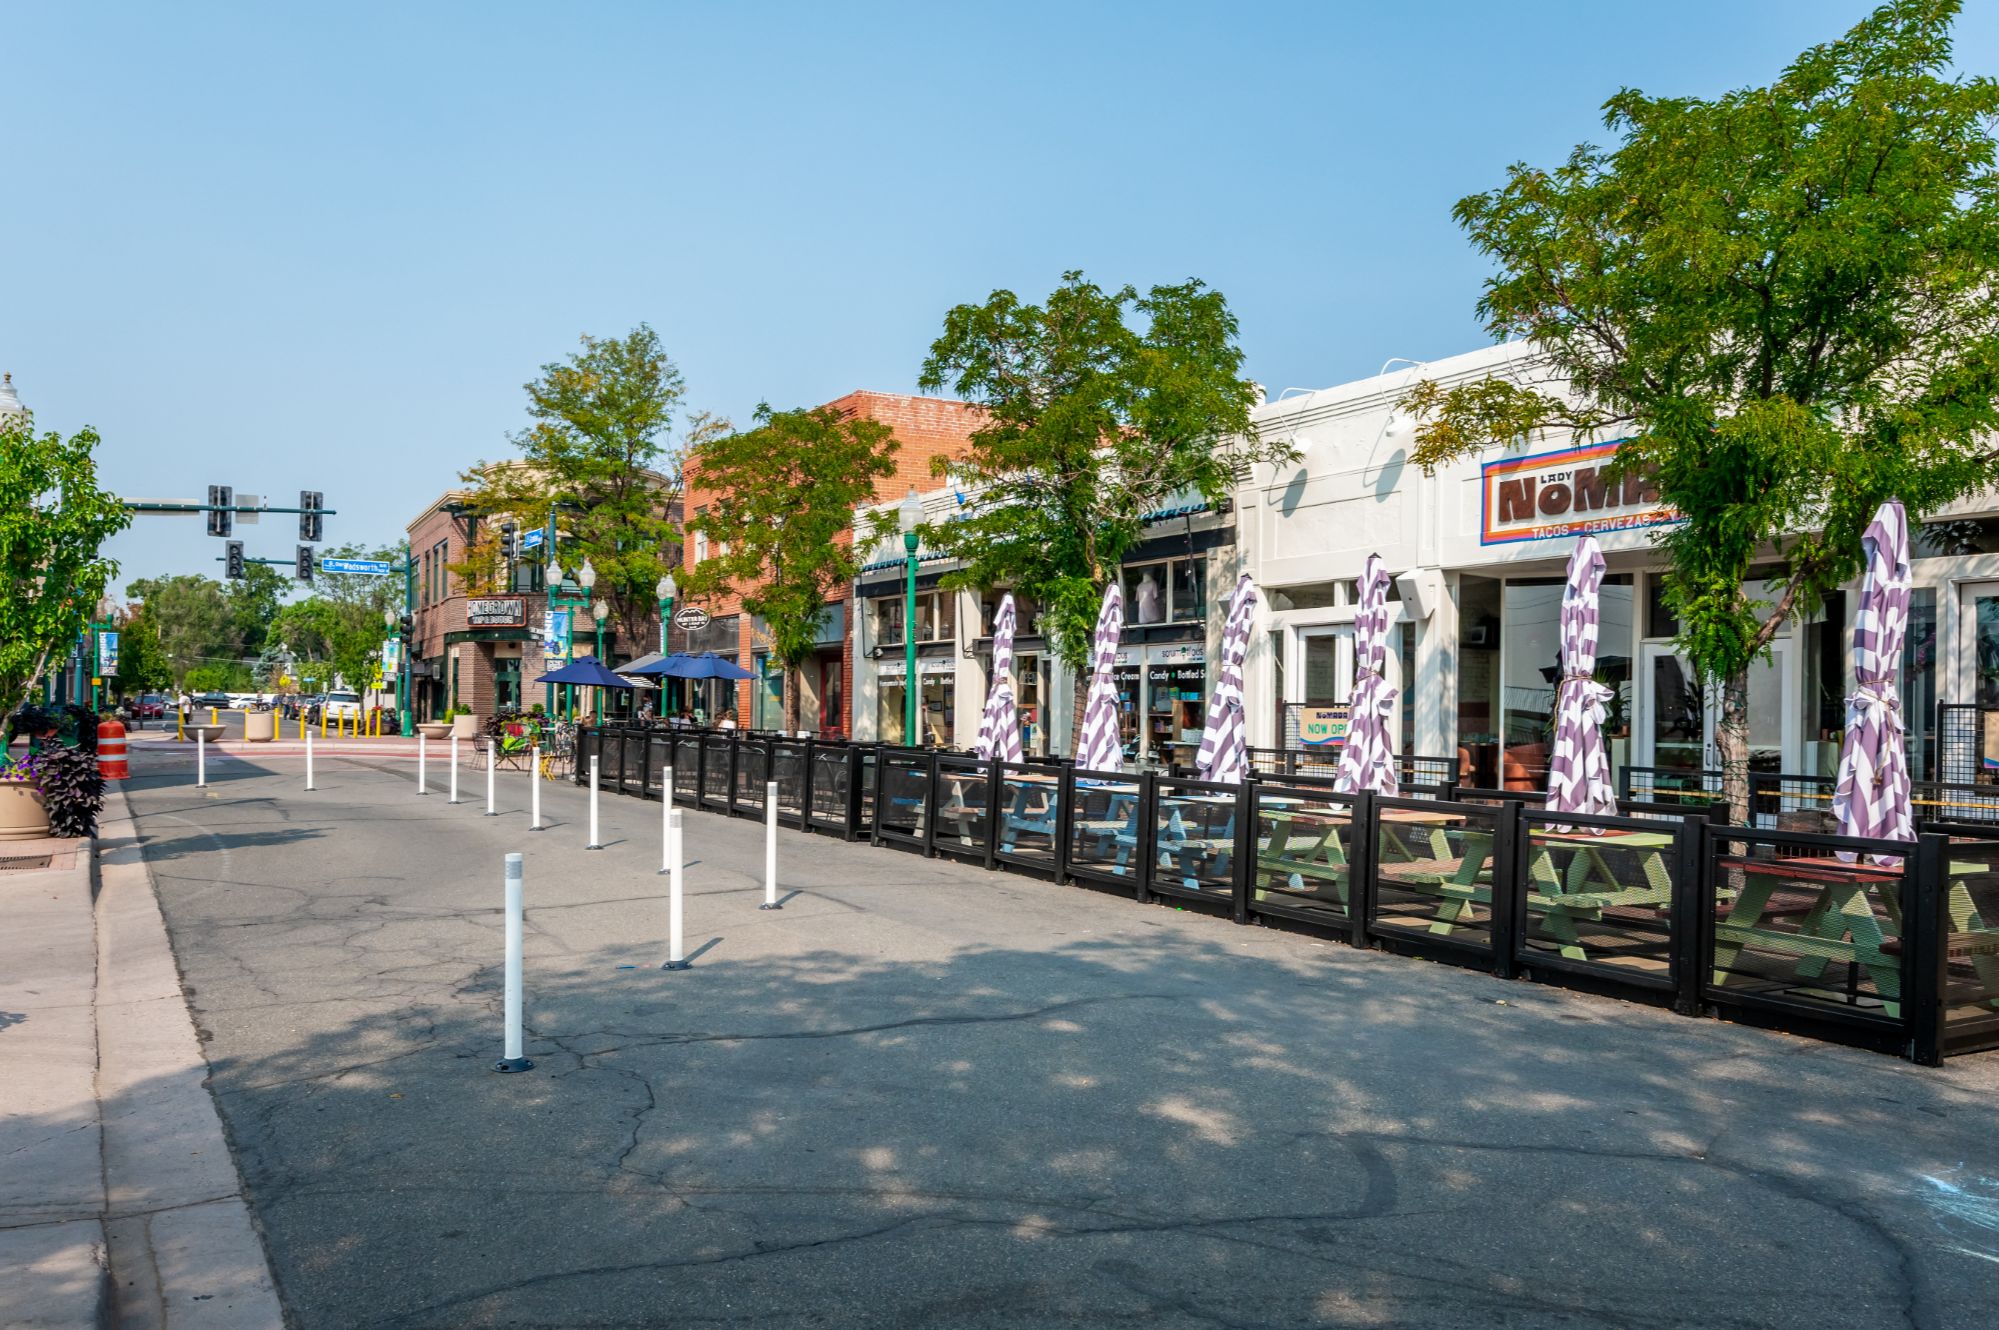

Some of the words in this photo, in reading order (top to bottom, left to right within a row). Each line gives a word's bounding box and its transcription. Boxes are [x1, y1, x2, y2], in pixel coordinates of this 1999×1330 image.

[1540, 471, 1573, 484] LADY
[1499, 461, 1661, 523] NOMA
[1532, 525, 1569, 540] TACOS
[1584, 515, 1650, 533] CERVEZAS
[467, 600, 522, 617] HOMEGROWN
[1121, 672, 1140, 680] Cream
[1150, 671, 1169, 681] Candy
[1308, 723, 1328, 734] NOW
